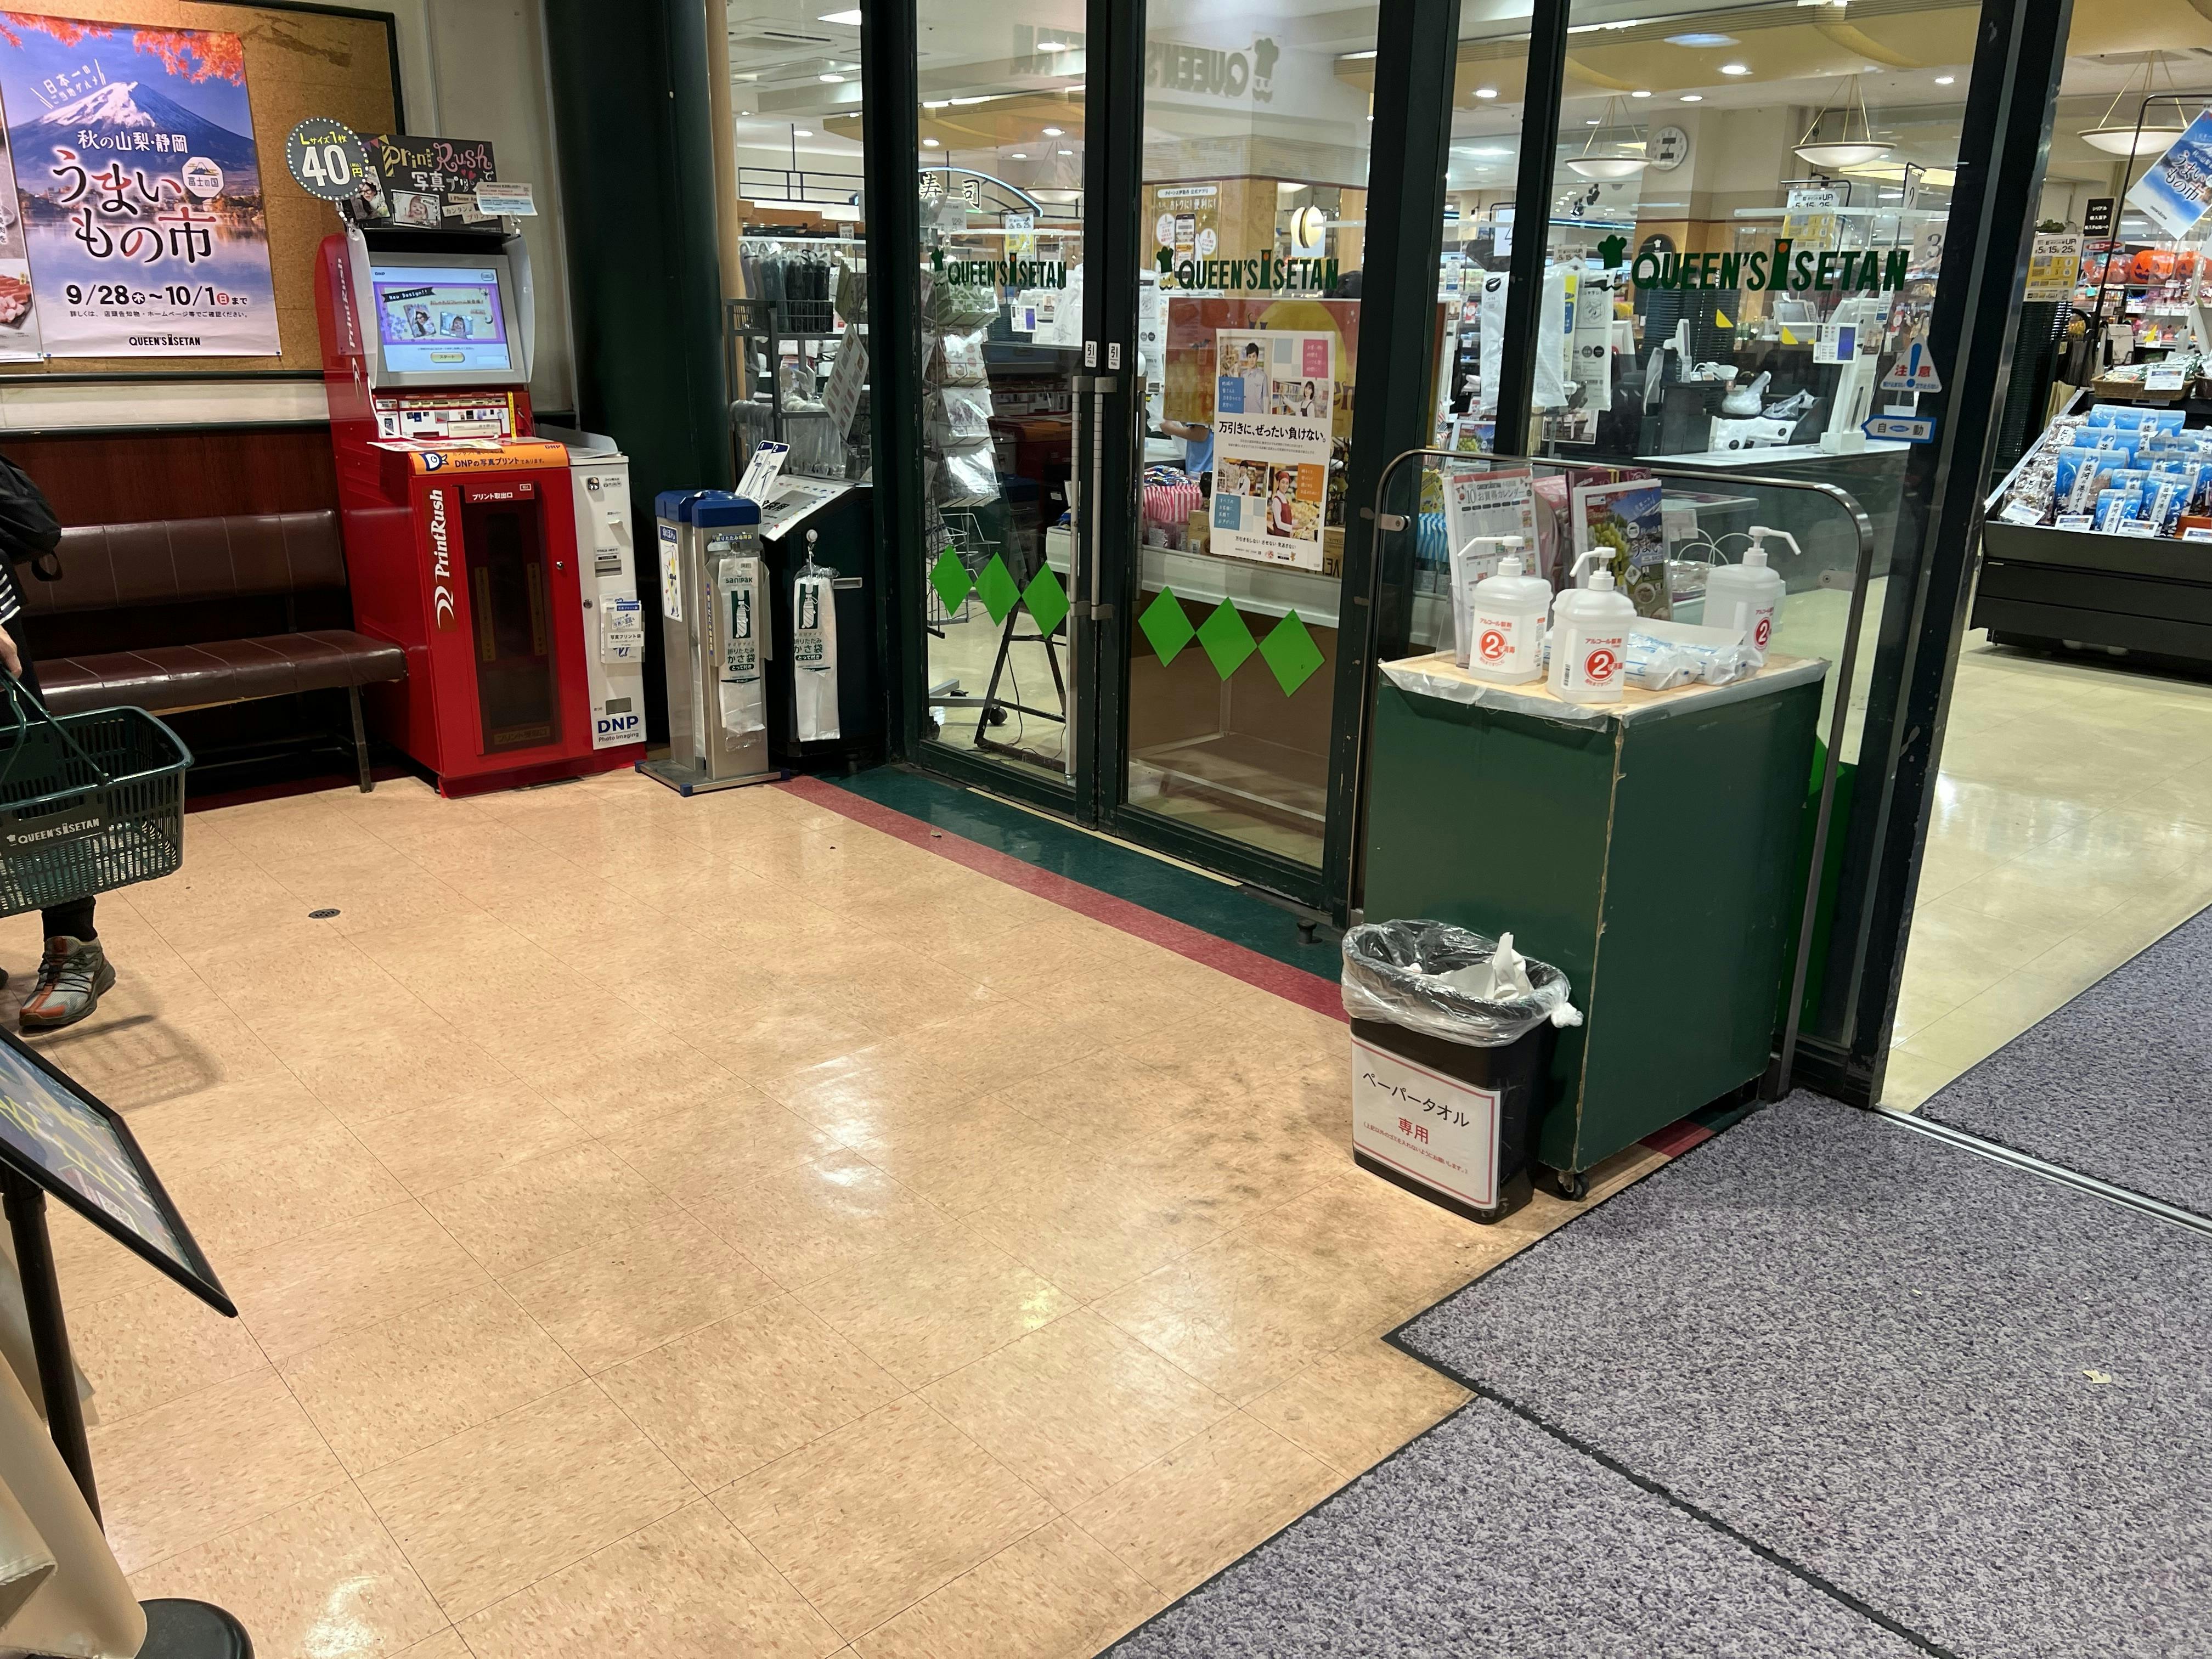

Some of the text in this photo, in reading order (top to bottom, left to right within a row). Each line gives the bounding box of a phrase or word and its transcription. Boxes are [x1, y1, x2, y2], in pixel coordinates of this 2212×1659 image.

[43, 65, 91, 94] 日本一の
[302, 145, 363, 187] 40 円
[381, 142, 493, 177] Print Rush
[2172, 150, 2206, 182] うまい
[53, 150, 182, 216] うまい
[921, 171, 981, 209] 寿司
[2165, 168, 2205, 201] もの市
[72, 207, 217, 263] もの市
[1927, 233, 1942, 258] 3
[948, 252, 1067, 289] QUEEN'S ISETAN
[1179, 250, 1339, 290] QUEEN'S ISETAN
[1632, 239, 1911, 291] QUEEN'S ISETAN
[129, 336, 167, 346] QUEEN'S
[1087, 344, 1094, 356] 引
[1111, 346, 1118, 358] 引
[1218, 421, 1326, 443] 万引きに、ぜったい負けない。
[472, 492, 513, 500] プリント取出口
[431, 489, 450, 578] PrintRush
[1235, 535, 1261, 544] 万引きをしない
[1485, 635, 1499, 656] 2
[1758, 622, 1768, 642] 2
[727, 653, 755, 664] かさ袋
[794, 644, 823, 653] かさ袋
[1592, 653, 1610, 675] 2
[598, 715, 639, 733] DNP
[18, 817, 100, 844] QUEEN'S ISETAN
[1363, 1072, 1470, 1127] ペーパータオル
[1398, 1117, 1429, 1144] 専用
